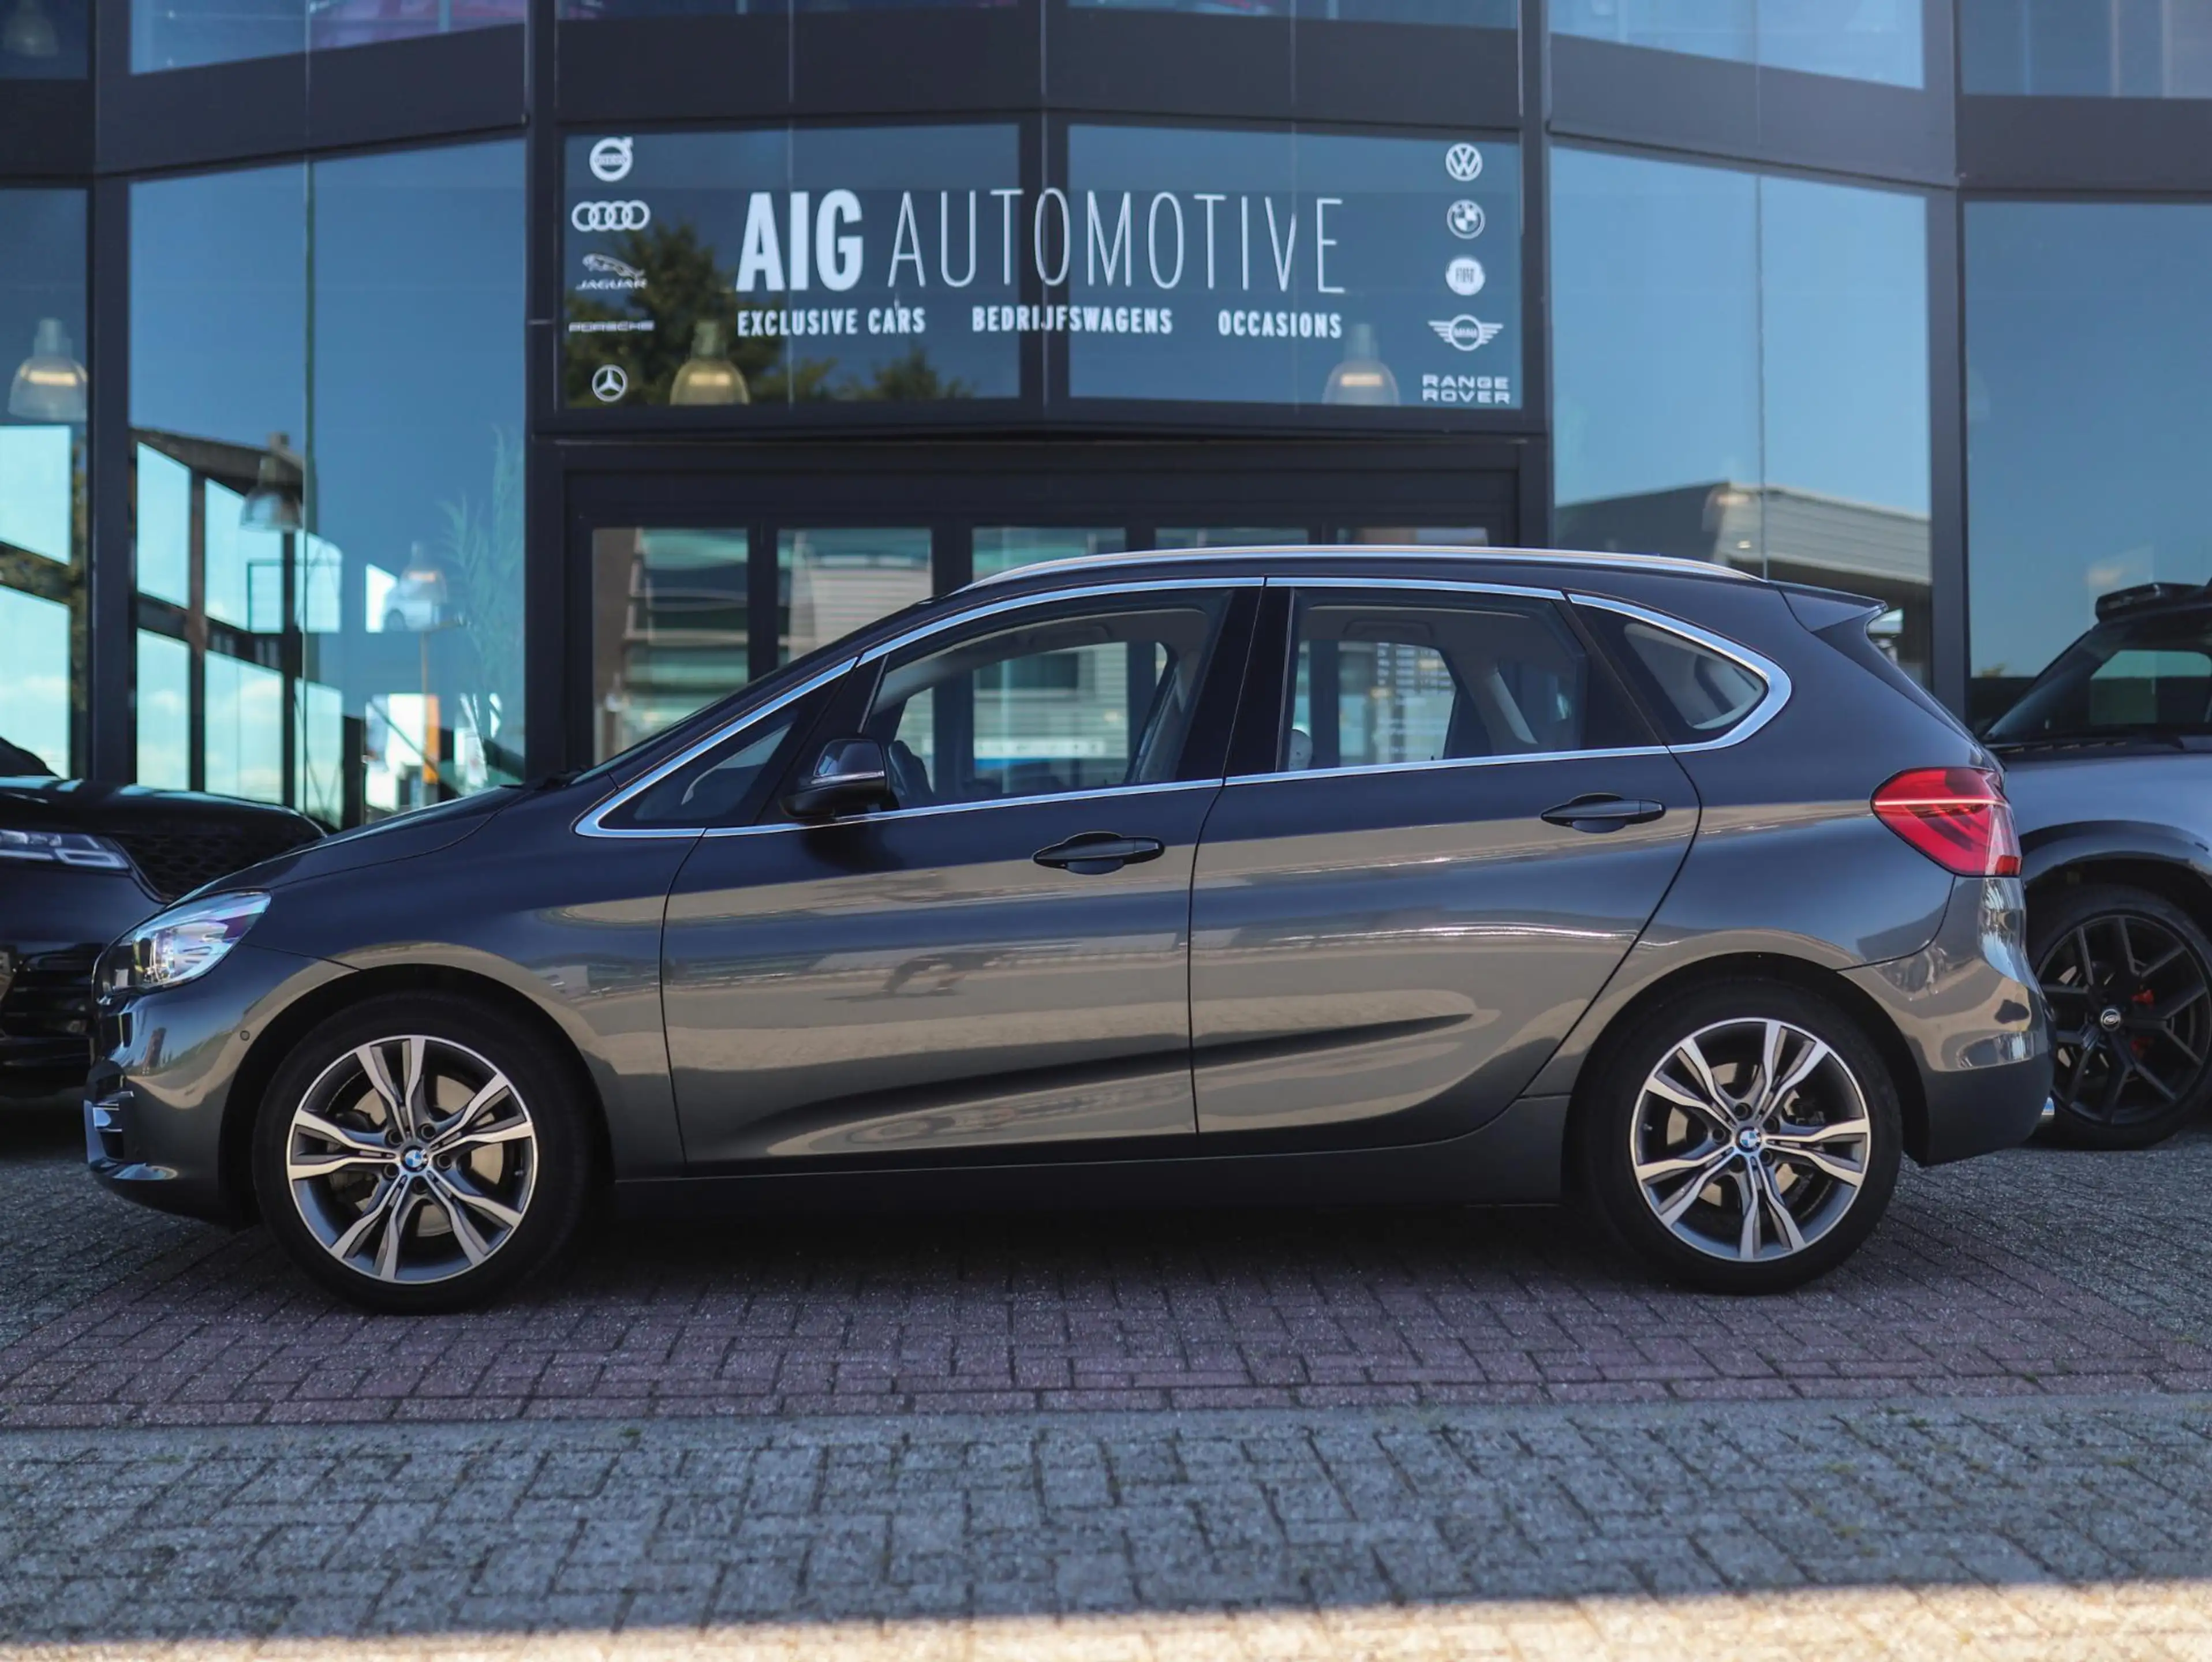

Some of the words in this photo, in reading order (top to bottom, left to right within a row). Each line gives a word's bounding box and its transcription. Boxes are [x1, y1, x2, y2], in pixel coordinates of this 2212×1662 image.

[736, 189, 864, 292] AIG
[888, 188, 1346, 293] AUTOMOTIVE
[737, 308, 858, 336] EXCLUSIVE
[868, 307, 926, 334] CARS
[972, 305, 1173, 334] BEDRIJFSWAGENS
[1217, 309, 1342, 338] OCCASIONS
[1422, 374, 1509, 390] RANGE
[1422, 388, 1510, 405] ROVER
